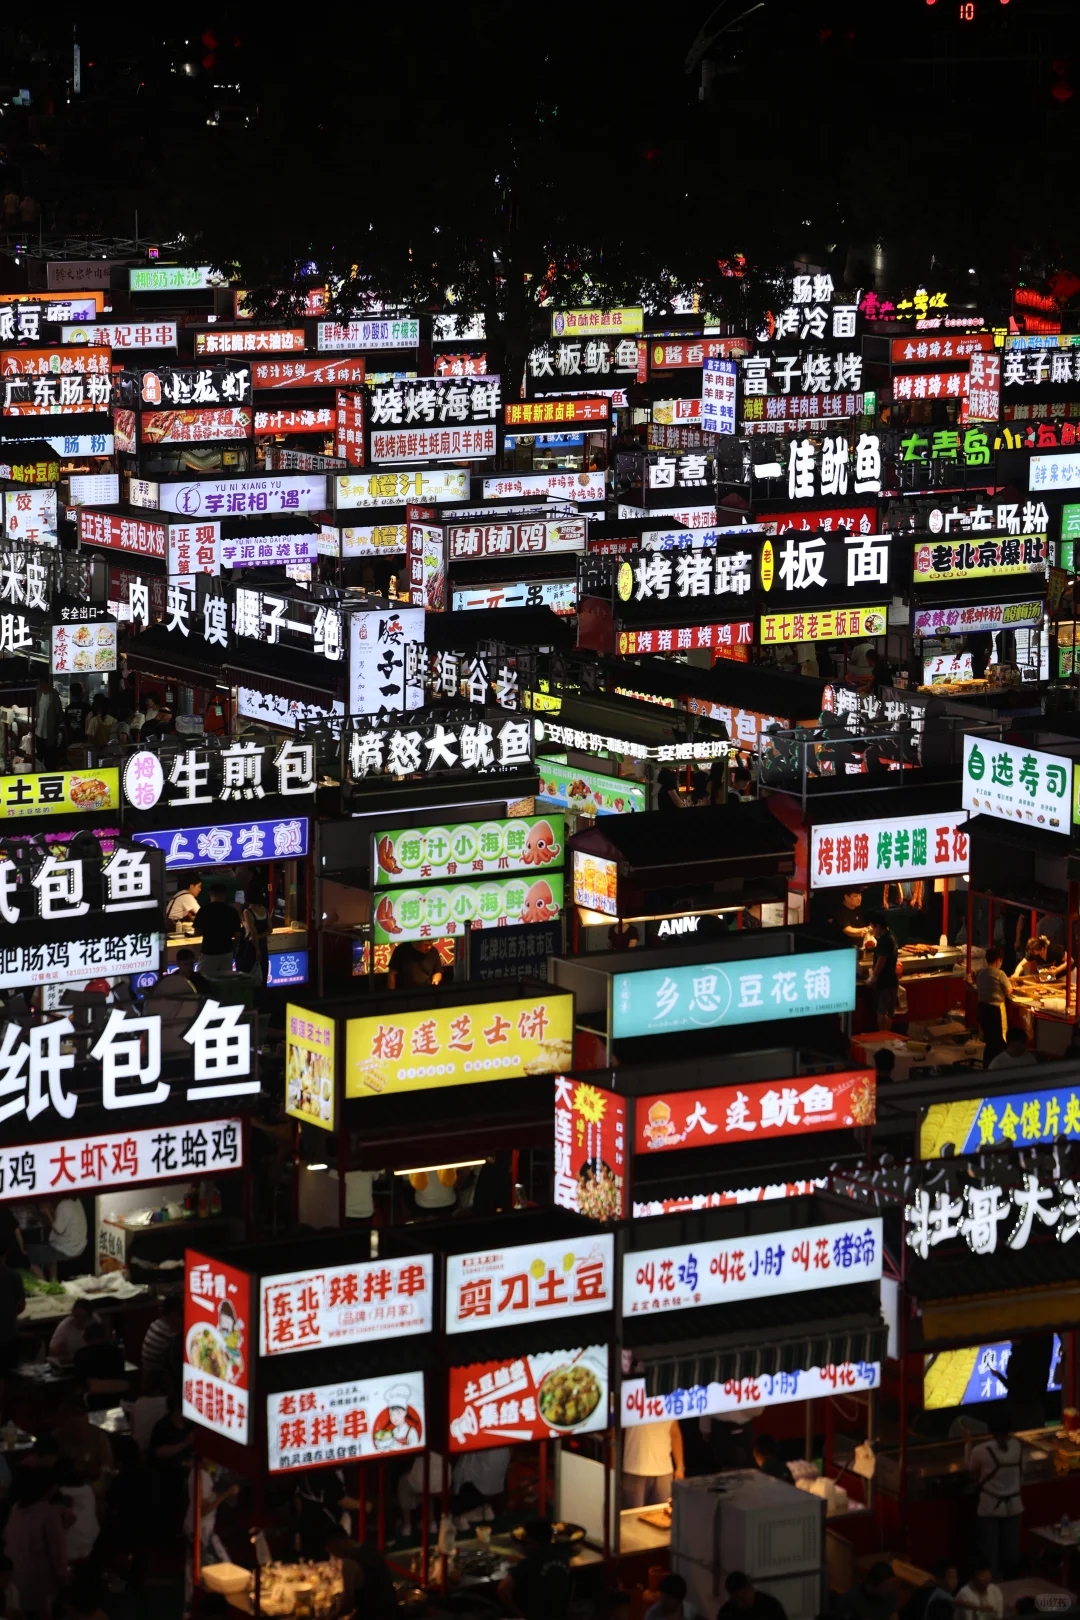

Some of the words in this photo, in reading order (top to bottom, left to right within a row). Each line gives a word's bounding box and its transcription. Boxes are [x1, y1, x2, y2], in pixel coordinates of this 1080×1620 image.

[960, 3, 974, 20] 10
[136, 270, 202, 288] 椰奶冰沙
[792, 274, 834, 303] 肠粉
[93, 325, 173, 347] 萧妃串串
[324, 322, 359, 342] 鲜榨果汁
[362, 322, 389, 341] 炒酸奶
[391, 321, 418, 340] 柠檬茶
[775, 305, 857, 340] 烤冷面
[206, 332, 294, 353] 东北脆皮大油边
[529, 339, 639, 377] 铁板鱿鱼
[903, 341, 953, 360] 金榜蹄名
[164, 369, 251, 404] 小龙虾
[704, 373, 735, 387] 羊肉串
[742, 352, 863, 396] 富子烧烤
[971, 353, 1000, 387] 英子
[1004, 352, 1080, 387] 英子麻
[3, 374, 112, 408] 广东肠粉
[371, 383, 500, 424] 烧烤海鲜
[704, 387, 735, 402] 羊腰子
[743, 396, 764, 420] 海鲜
[766, 396, 787, 419] 烧烤
[789, 395, 819, 418] 羊肉串
[822, 395, 842, 417] 生蚝
[968, 388, 999, 419] 麻辣烫
[254, 409, 332, 429] 捞汁小海鲜
[703, 403, 734, 418] 生蚝
[703, 418, 733, 434] 扇贝
[63, 436, 107, 454] 肠粉
[373, 428, 494, 458] 烧烤海鲜生蚝扇贝羊肉串
[650, 454, 708, 488] 卤煮
[754, 433, 881, 499] 一佳鱿鱼
[228, 483, 239, 491] NI
[241, 481, 267, 490] XIANG
[270, 480, 282, 489] YU
[368, 473, 429, 498] 橙汁
[85, 513, 165, 555] 正定第一家现包水饺
[763, 549, 772, 581] 老三
[779, 534, 892, 591] 板面
[932, 537, 1044, 573] 老北京爆肚
[635, 551, 753, 601] 烤猪蹄
[61, 606, 97, 620] 安全出口
[129, 576, 229, 649] 肉夹馍
[764, 610, 861, 642] 五七路老三板面
[638, 623, 751, 652] 烤猪蹄烤鸡爪
[168, 740, 318, 807] 生煎包
[967, 743, 1068, 798] 自选寿司
[6, 775, 65, 806] 土豆
[166, 820, 302, 862] 上海生煎
[400, 829, 526, 861] 捞汁小海鲜
[817, 833, 869, 876] 烤猪蹄
[876, 827, 928, 870] 烤羊腿
[420, 856, 509, 877] 无骨鸡爪
[400, 889, 526, 921] 捞汁小海鲜
[80, 931, 152, 965] 花蛤鸡
[372, 1004, 549, 1061] 榴莲芝士饼
[0, 999, 261, 1122] 纸包鱼
[686, 1083, 834, 1135] 大连鱿鱼
[0, 1151, 36, 1194] 鸡
[50, 1138, 139, 1187] 大虾鸡
[151, 1125, 238, 1173] 花蛤鸡
[635, 1252, 698, 1294] 叫花鸡
[709, 1244, 785, 1284] 叫花小肘
[791, 1227, 876, 1272] 叫花猪蹄
[273, 1286, 321, 1317] 东北
[329, 1264, 426, 1307] 辣拌串
[457, 1261, 607, 1321] 剪刀土豆
[273, 1312, 321, 1344] 老式
[625, 1383, 709, 1420] 叫花猪蹄
[723, 1368, 801, 1405] 叫花小肘
[819, 1360, 876, 1389] 叫花鸡
[279, 1409, 369, 1452] 辣拌串
